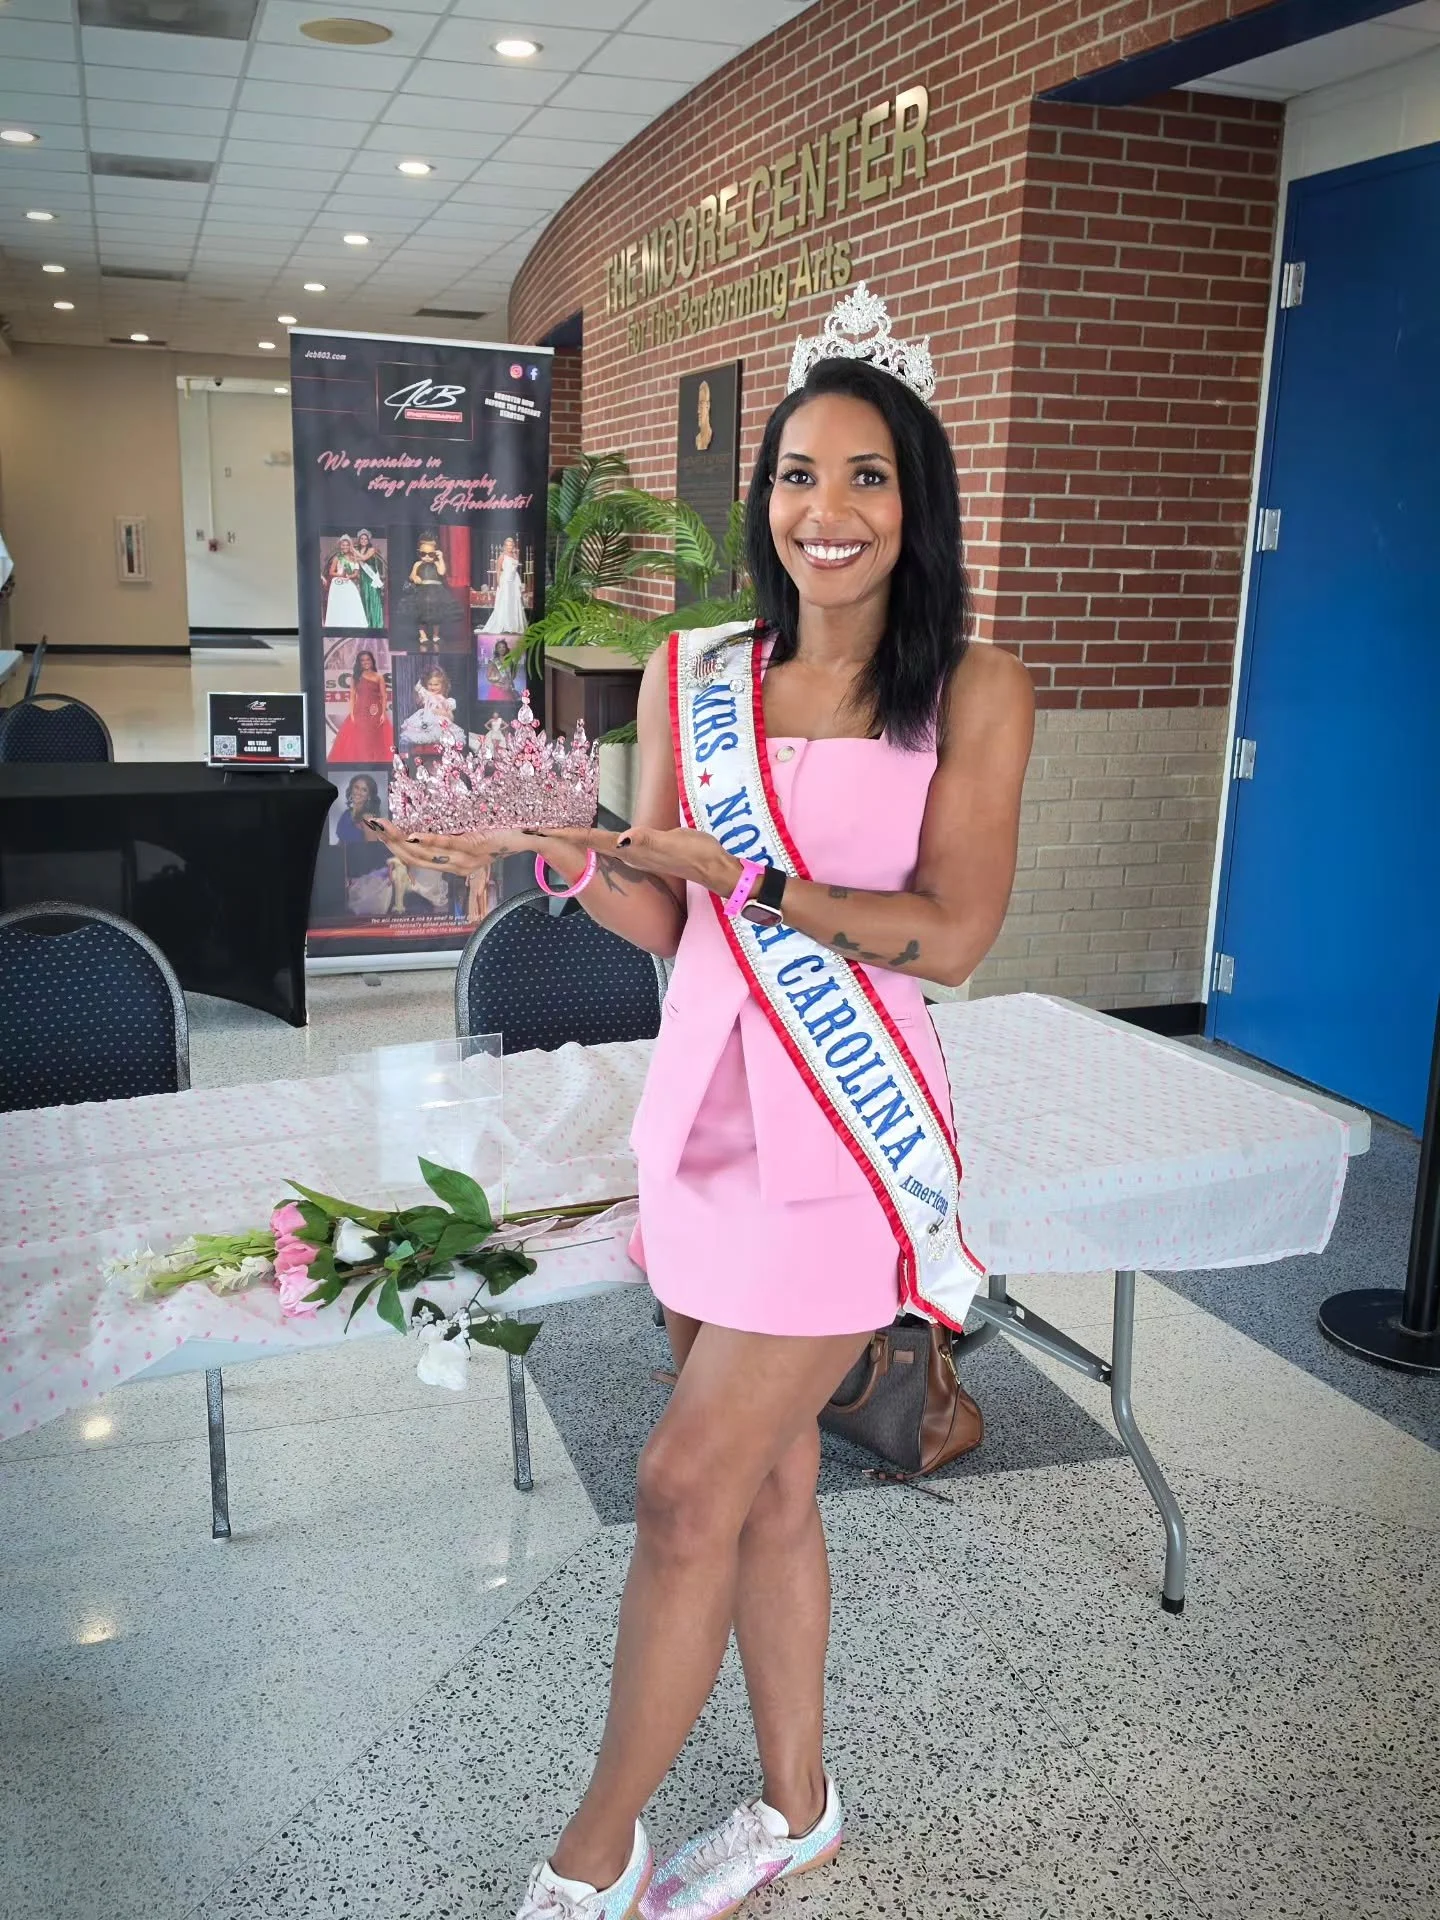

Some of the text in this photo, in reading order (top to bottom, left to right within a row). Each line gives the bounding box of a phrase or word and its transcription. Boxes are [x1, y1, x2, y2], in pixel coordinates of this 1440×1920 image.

[603, 84, 930, 317] THE MOORE CENTER
[627, 234, 853, 356] For The Performing Arts
[317, 450, 444, 476] We specialize in
[367, 473, 498, 498] stage photography
[691, 683, 739, 763] MRS
[776, 953, 928, 1173] CAROLINA
